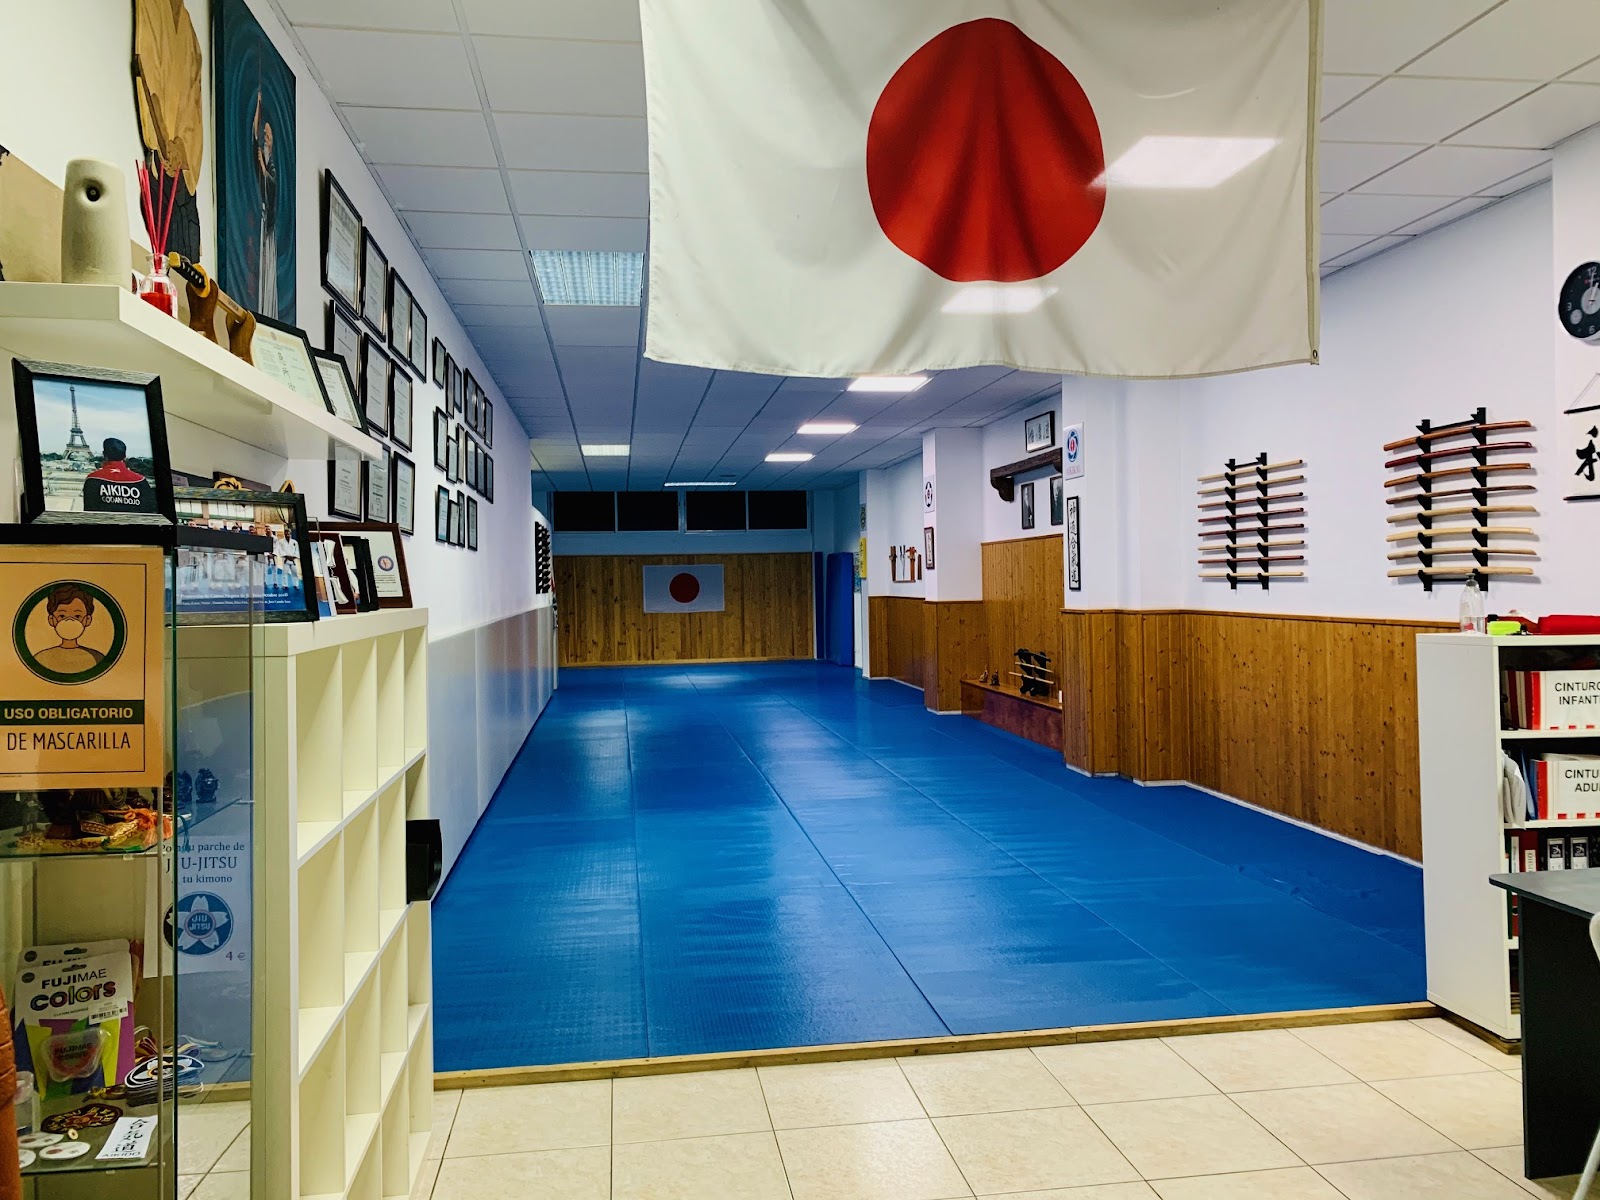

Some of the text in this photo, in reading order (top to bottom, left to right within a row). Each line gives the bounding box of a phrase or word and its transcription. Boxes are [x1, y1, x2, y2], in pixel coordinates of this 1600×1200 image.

[1589, 325, 1596, 334] 6
[100, 484, 140, 498] AIKIDO
[123, 497, 140, 505] DOJO
[4, 707, 134, 719] USO OBLIGATORIO
[7, 731, 131, 750] DE MASCARILLA
[197, 842, 231, 854] parche
[233, 842, 245, 851] de
[166, 856, 238, 873] JU-JITSU
[182, 874, 233, 883] tu kimono
[191, 914, 208, 923] JIU
[189, 922, 211, 931] JITSU
[225, 951, 233, 961] 4
[41, 968, 108, 989] FUJIMAE
[30, 981, 116, 1011] colors
